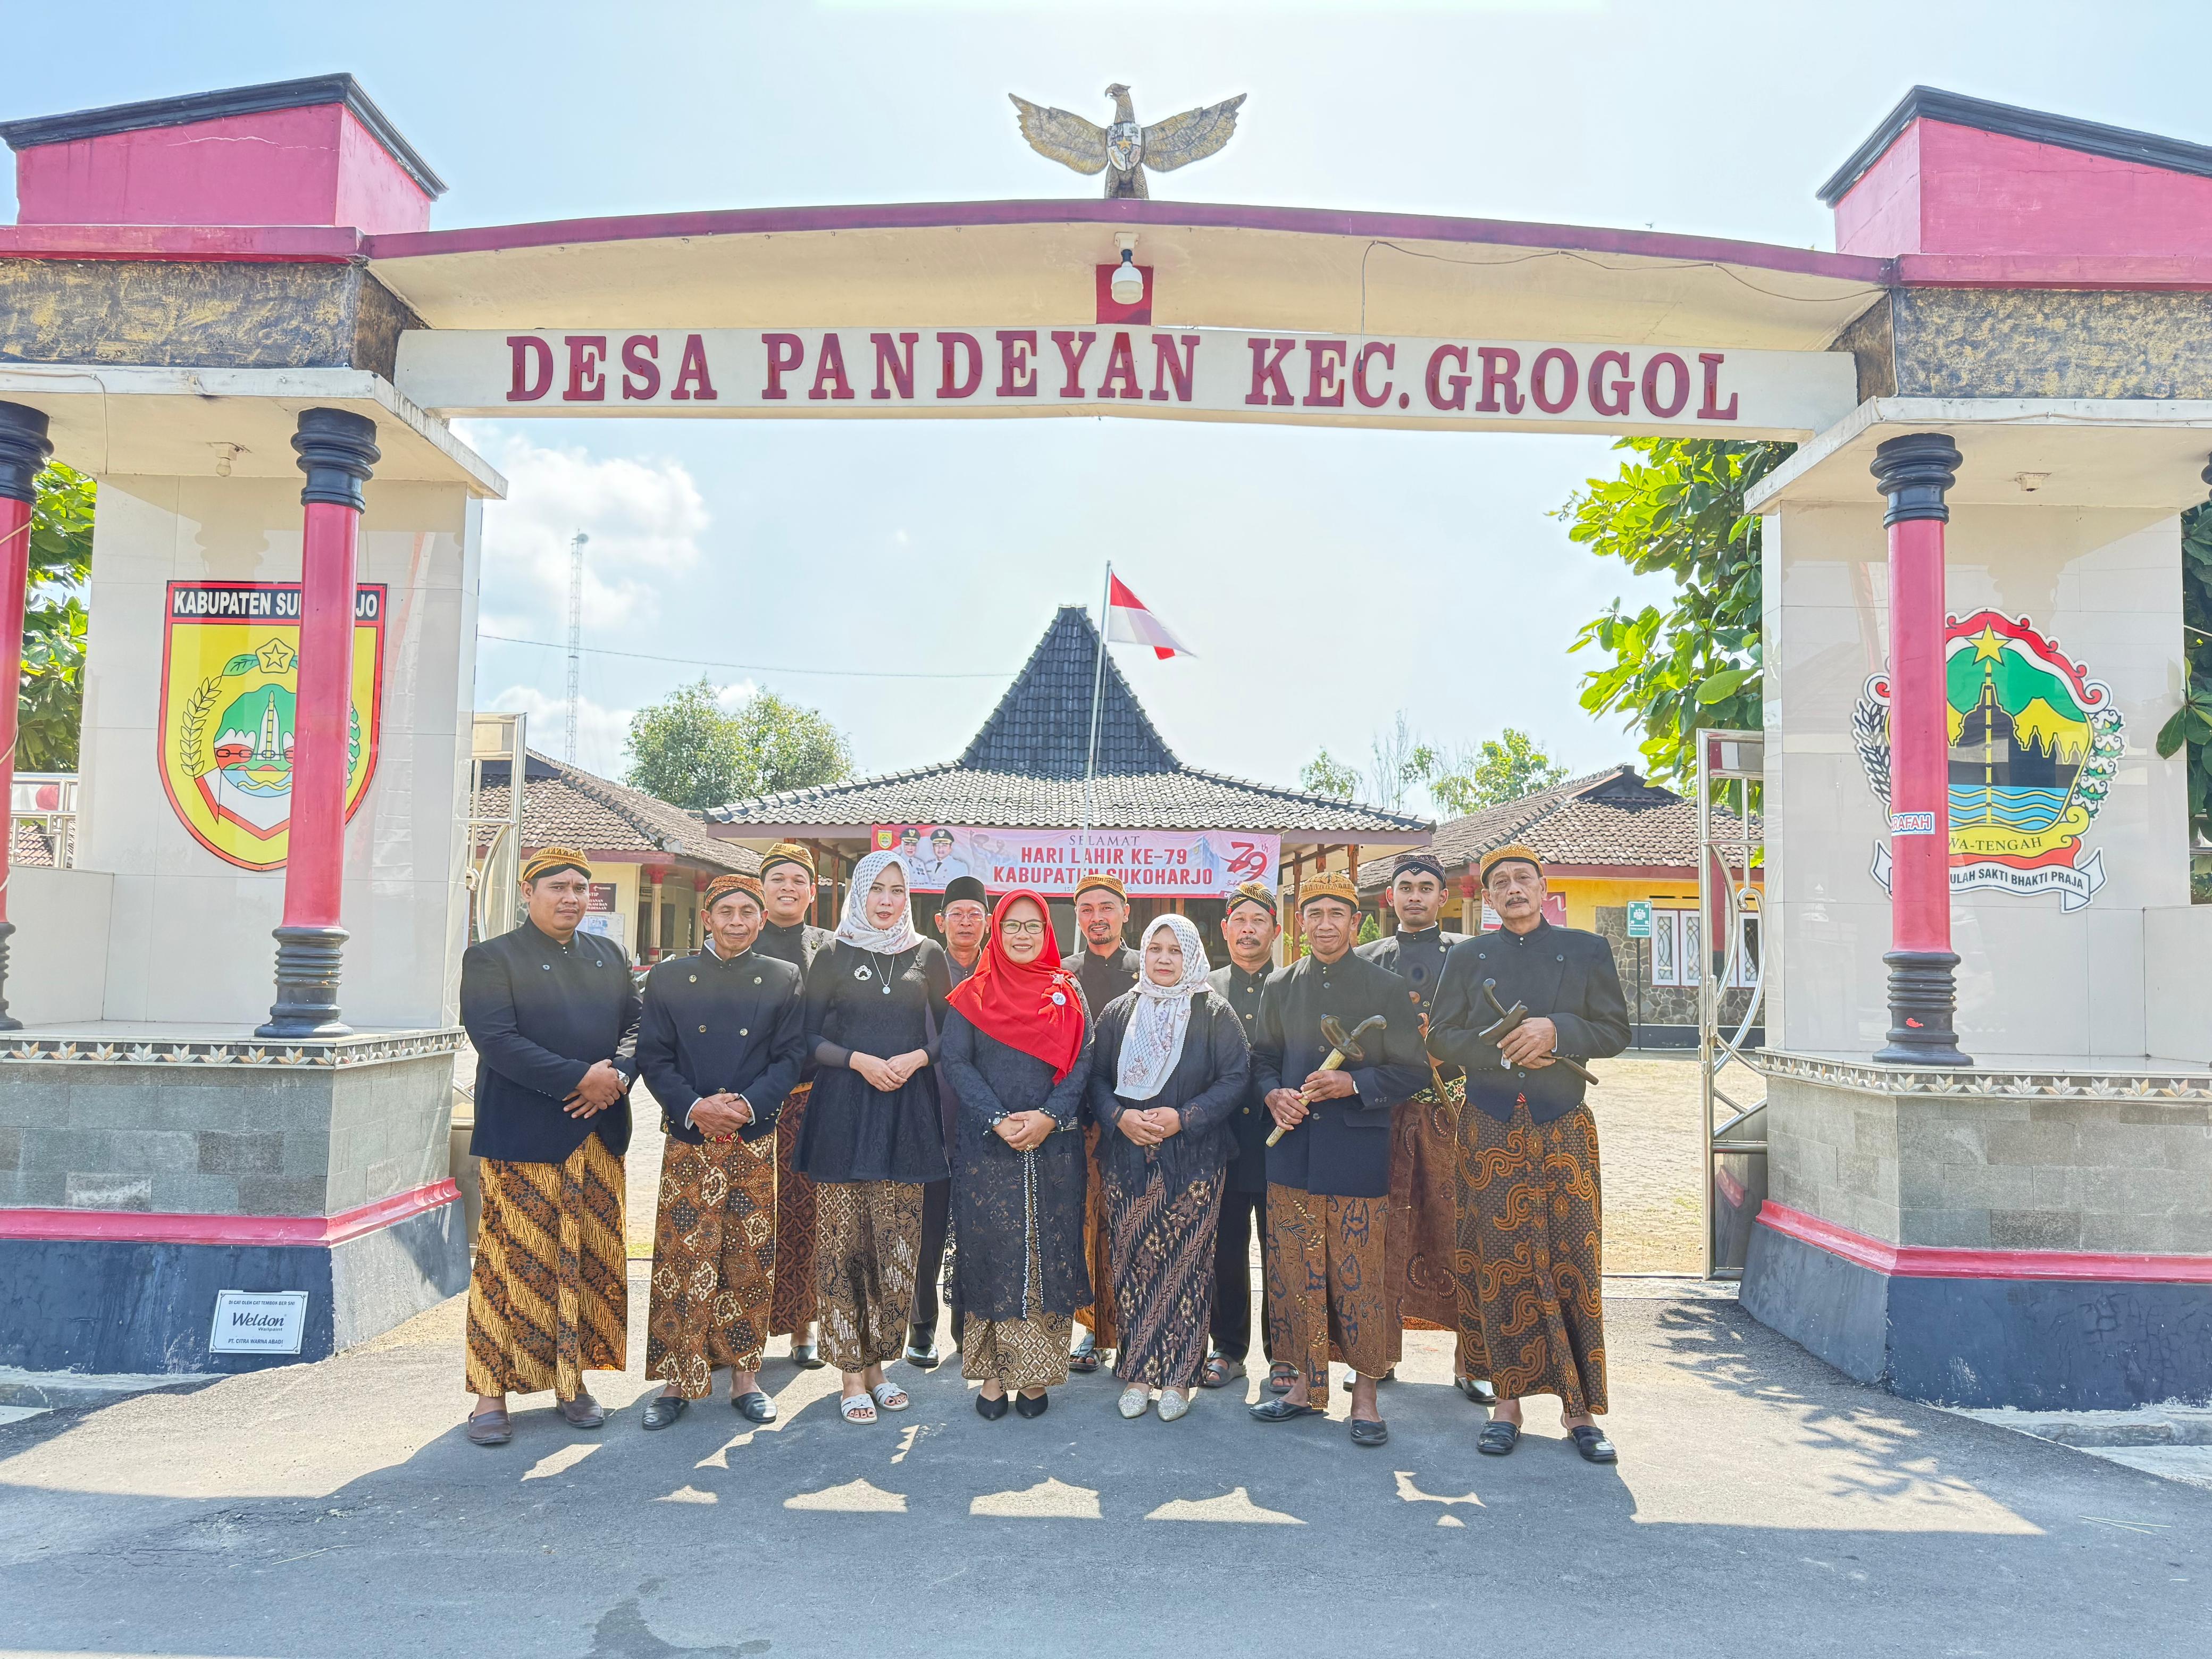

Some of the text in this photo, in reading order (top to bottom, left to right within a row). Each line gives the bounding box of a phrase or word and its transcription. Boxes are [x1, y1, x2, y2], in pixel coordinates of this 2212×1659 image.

[506, 333, 718, 401] DESA
[761, 330, 1200, 402] PANDEYAN
[173, 591, 271, 616] KABUPATEN
[1891, 816, 1930, 830] RAFAH
[1069, 835, 1140, 845] SELAMAT
[1949, 836, 2043, 851] WA-TENGAH
[1021, 847, 1187, 865] HARI LAHIR KE-79
[1950, 868, 2083, 890] ULAH SAKTI BHAKTI PRAJA
[232, 1312, 284, 1326] Weldon
